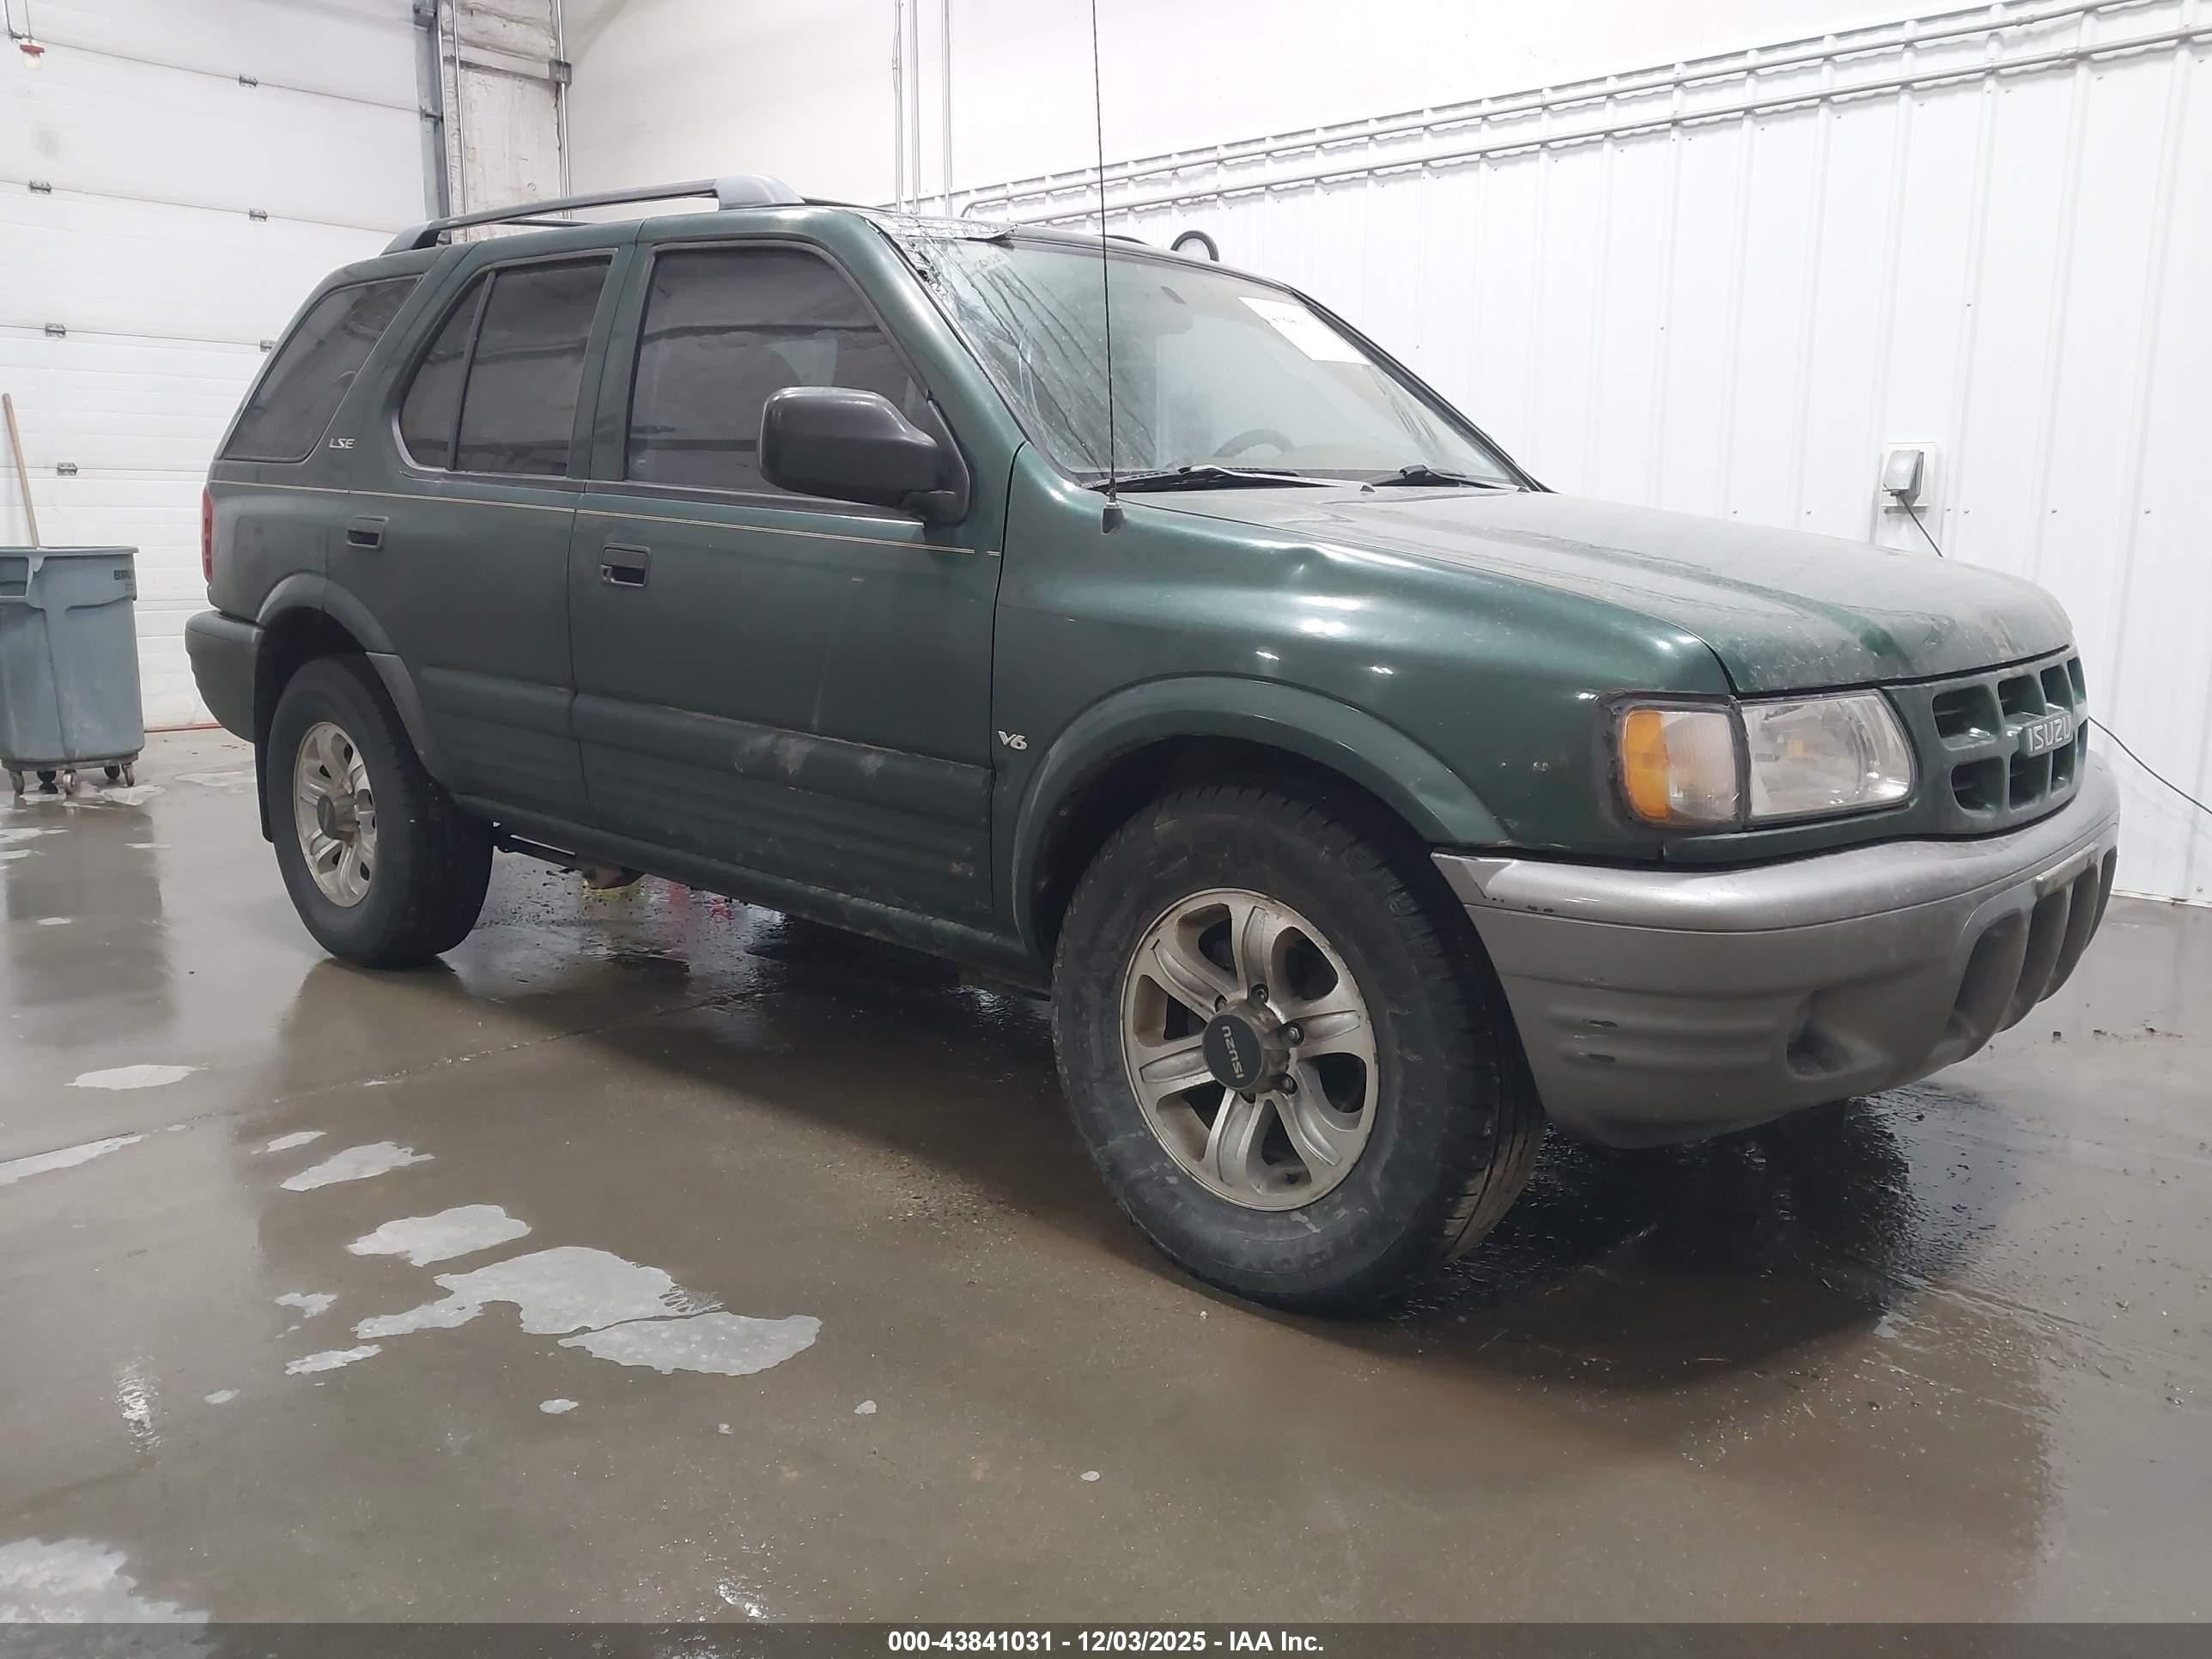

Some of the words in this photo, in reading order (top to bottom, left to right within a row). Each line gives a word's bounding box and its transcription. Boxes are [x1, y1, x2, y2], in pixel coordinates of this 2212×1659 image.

[329, 438, 356, 449] LSE
[997, 731, 1028, 750] V6
[2027, 714, 2072, 752] ISUZU
[1221, 1024, 1245, 1079] ISUZU
